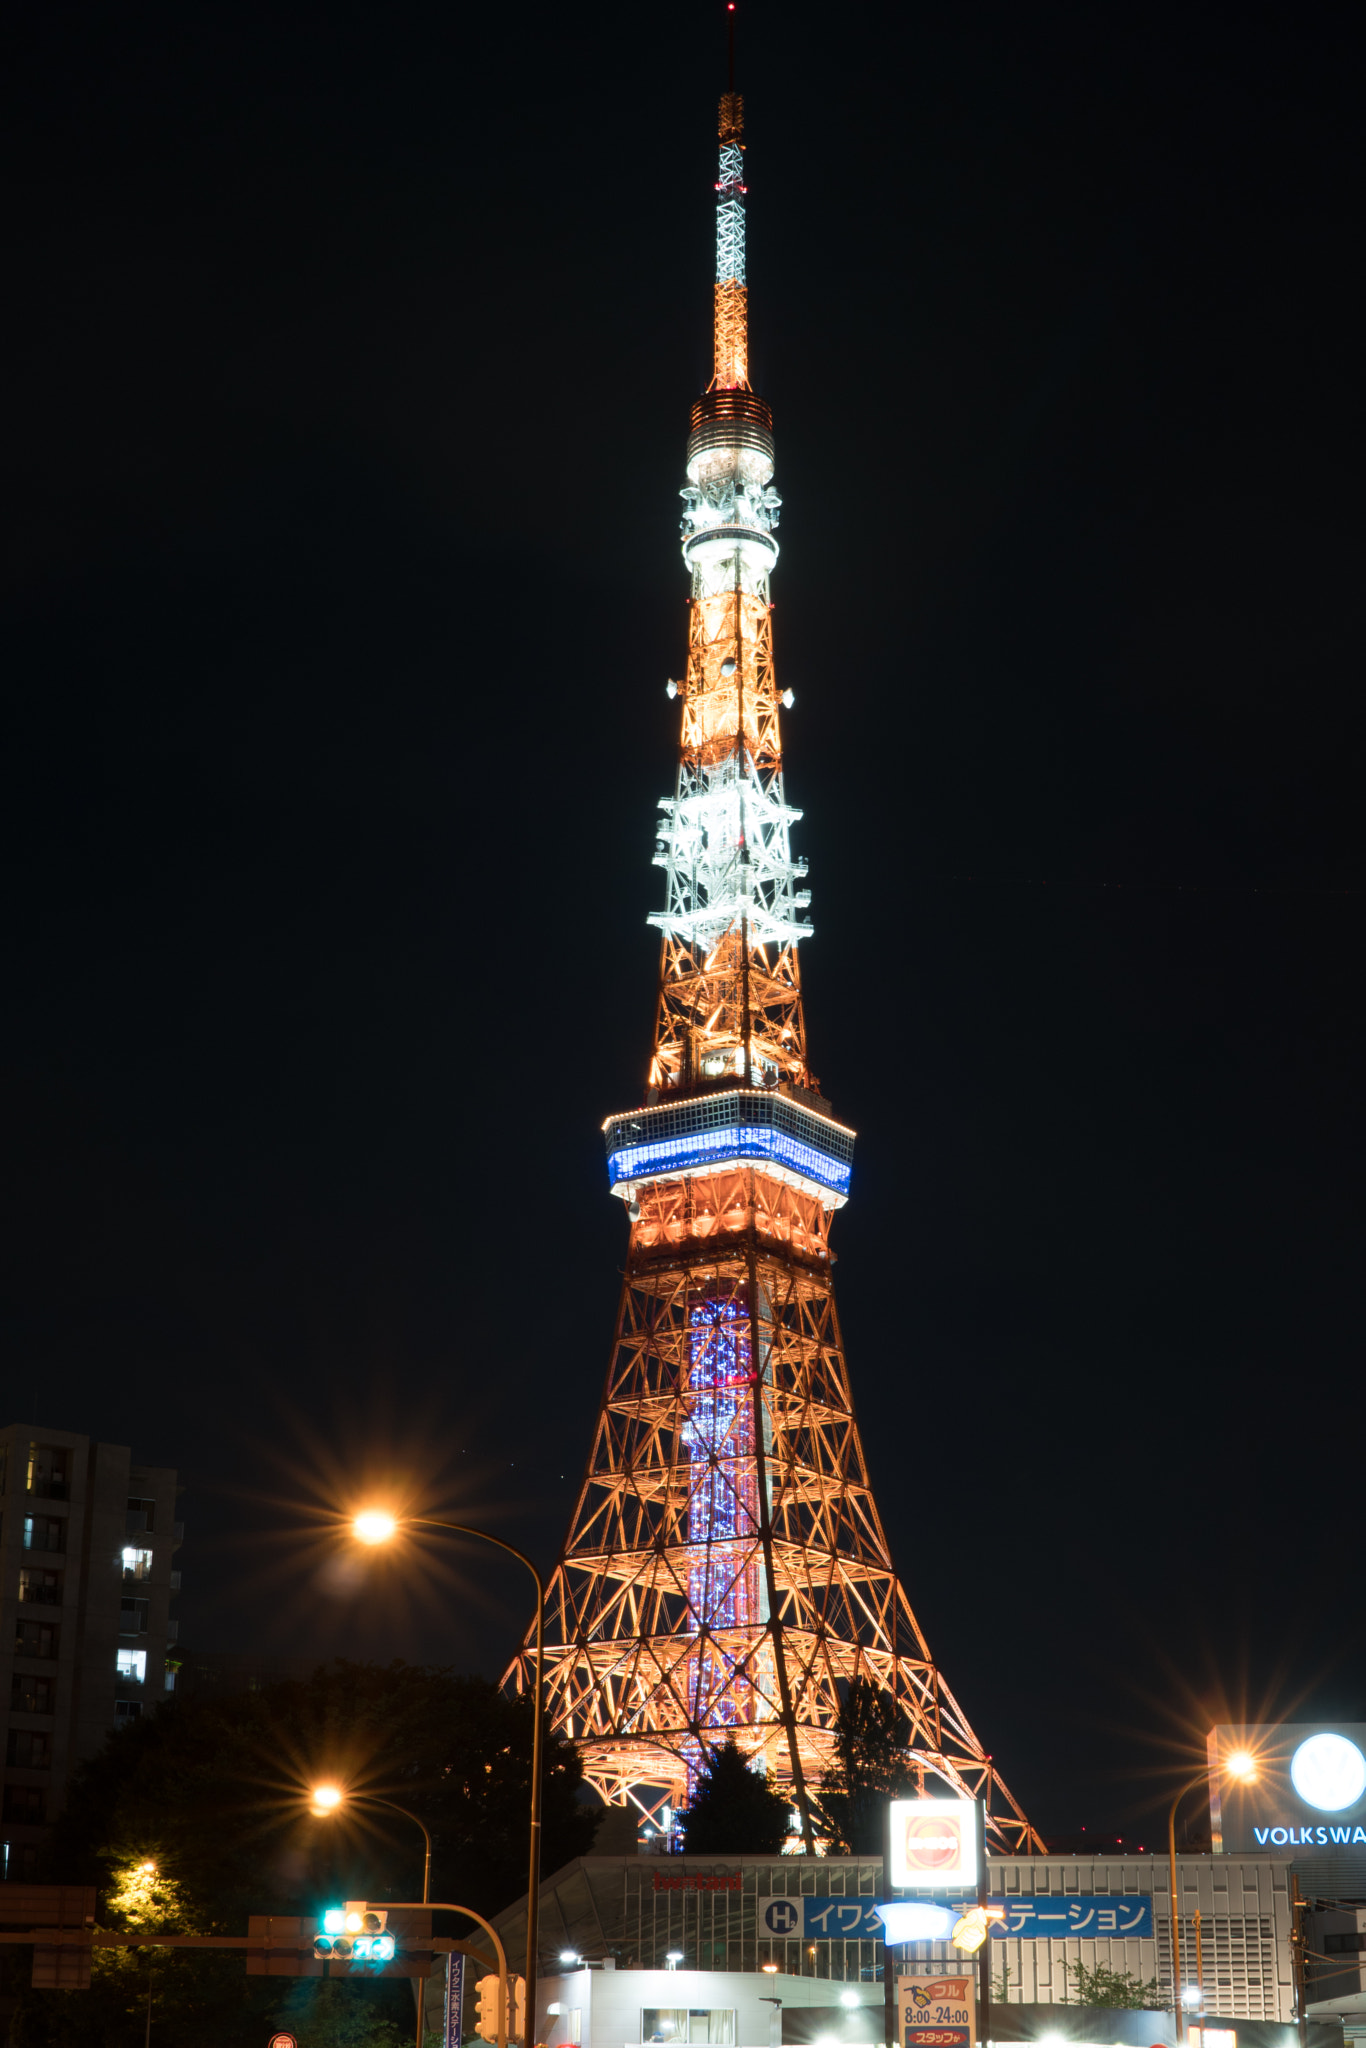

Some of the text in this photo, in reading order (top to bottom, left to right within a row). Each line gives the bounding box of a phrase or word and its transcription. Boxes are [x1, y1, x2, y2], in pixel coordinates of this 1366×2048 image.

[1253, 1826, 1366, 1845] VOLKSWA
[653, 1871, 742, 1891] Iwatani
[935, 1984, 960, 1997] フル
[916, 2032, 960, 2044] スタッフが
